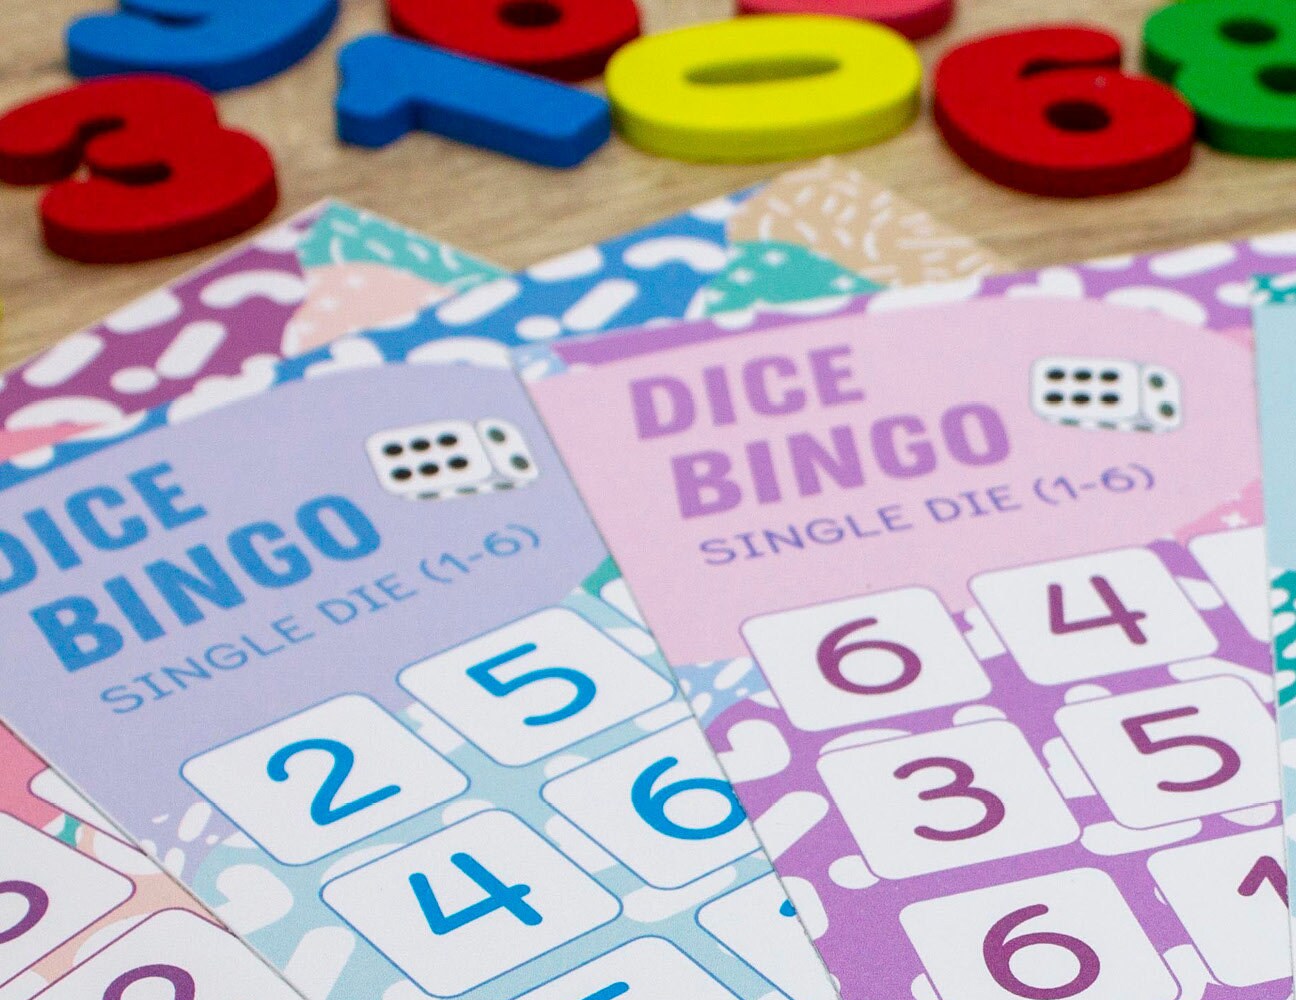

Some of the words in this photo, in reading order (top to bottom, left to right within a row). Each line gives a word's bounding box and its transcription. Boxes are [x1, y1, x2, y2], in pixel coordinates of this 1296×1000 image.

[0, 74, 278, 262] 3
[336, 34, 611, 168] 1
[933, 25, 1196, 197] 6
[629, 344, 866, 441] DICE
[670, 403, 1011, 519] BINGO
[699, 504, 913, 565] SINGLE
[925, 485, 1023, 523] DIE
[1033, 464, 1156, 507] (1-6)
[29, 494, 381, 673] BINGO
[100, 615, 315, 715] SINGLE
[317, 572, 416, 626] DIE
[420, 524, 541, 584] (1-6)
[815, 617, 922, 696] 6
[1046, 573, 1149, 646] 4
[266, 738, 402, 827] 2
[466, 642, 598, 727] 5
[893, 756, 1006, 842] 3
[1121, 706, 1242, 792] 5
[407, 851, 544, 936] 4
[630, 755, 748, 841] 6
[982, 903, 1101, 1000] 6
